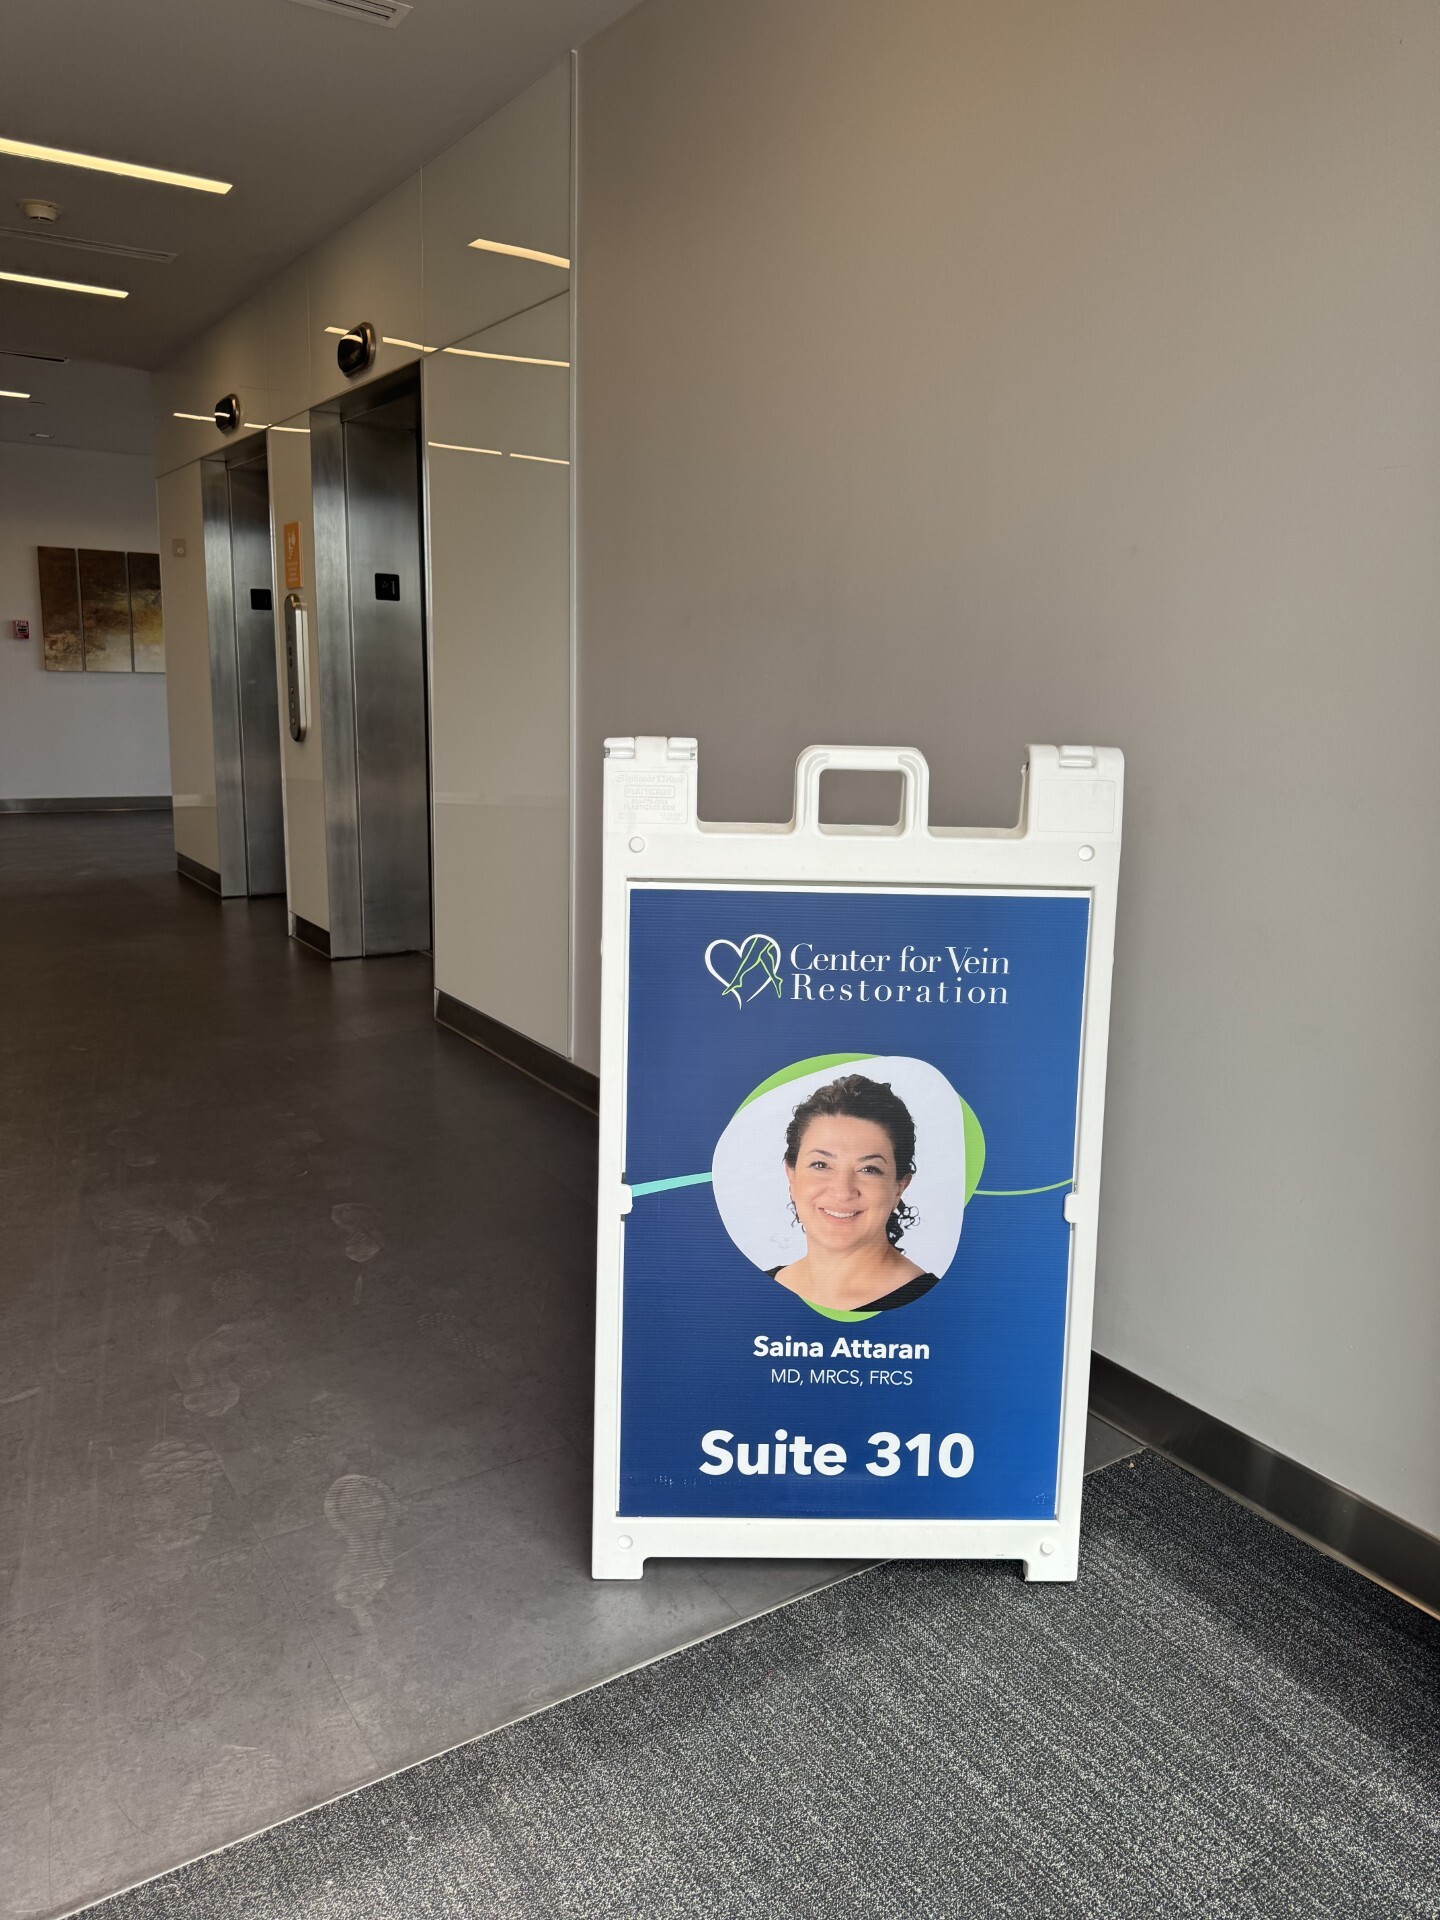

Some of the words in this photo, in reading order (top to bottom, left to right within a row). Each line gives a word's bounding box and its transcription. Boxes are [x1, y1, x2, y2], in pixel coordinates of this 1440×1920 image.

[791, 943, 890, 972] Center
[900, 946, 941, 973] for
[945, 947, 1008, 975] Vein
[791, 974, 1007, 1003] Restoration
[753, 1336, 823, 1357] Saina
[831, 1338, 929, 1359] Attaran
[772, 1369, 803, 1385] MD,
[811, 1370, 863, 1386] MRCS,
[870, 1371, 912, 1385] FRCS
[699, 1429, 846, 1475] Suite
[866, 1432, 974, 1478] 310
